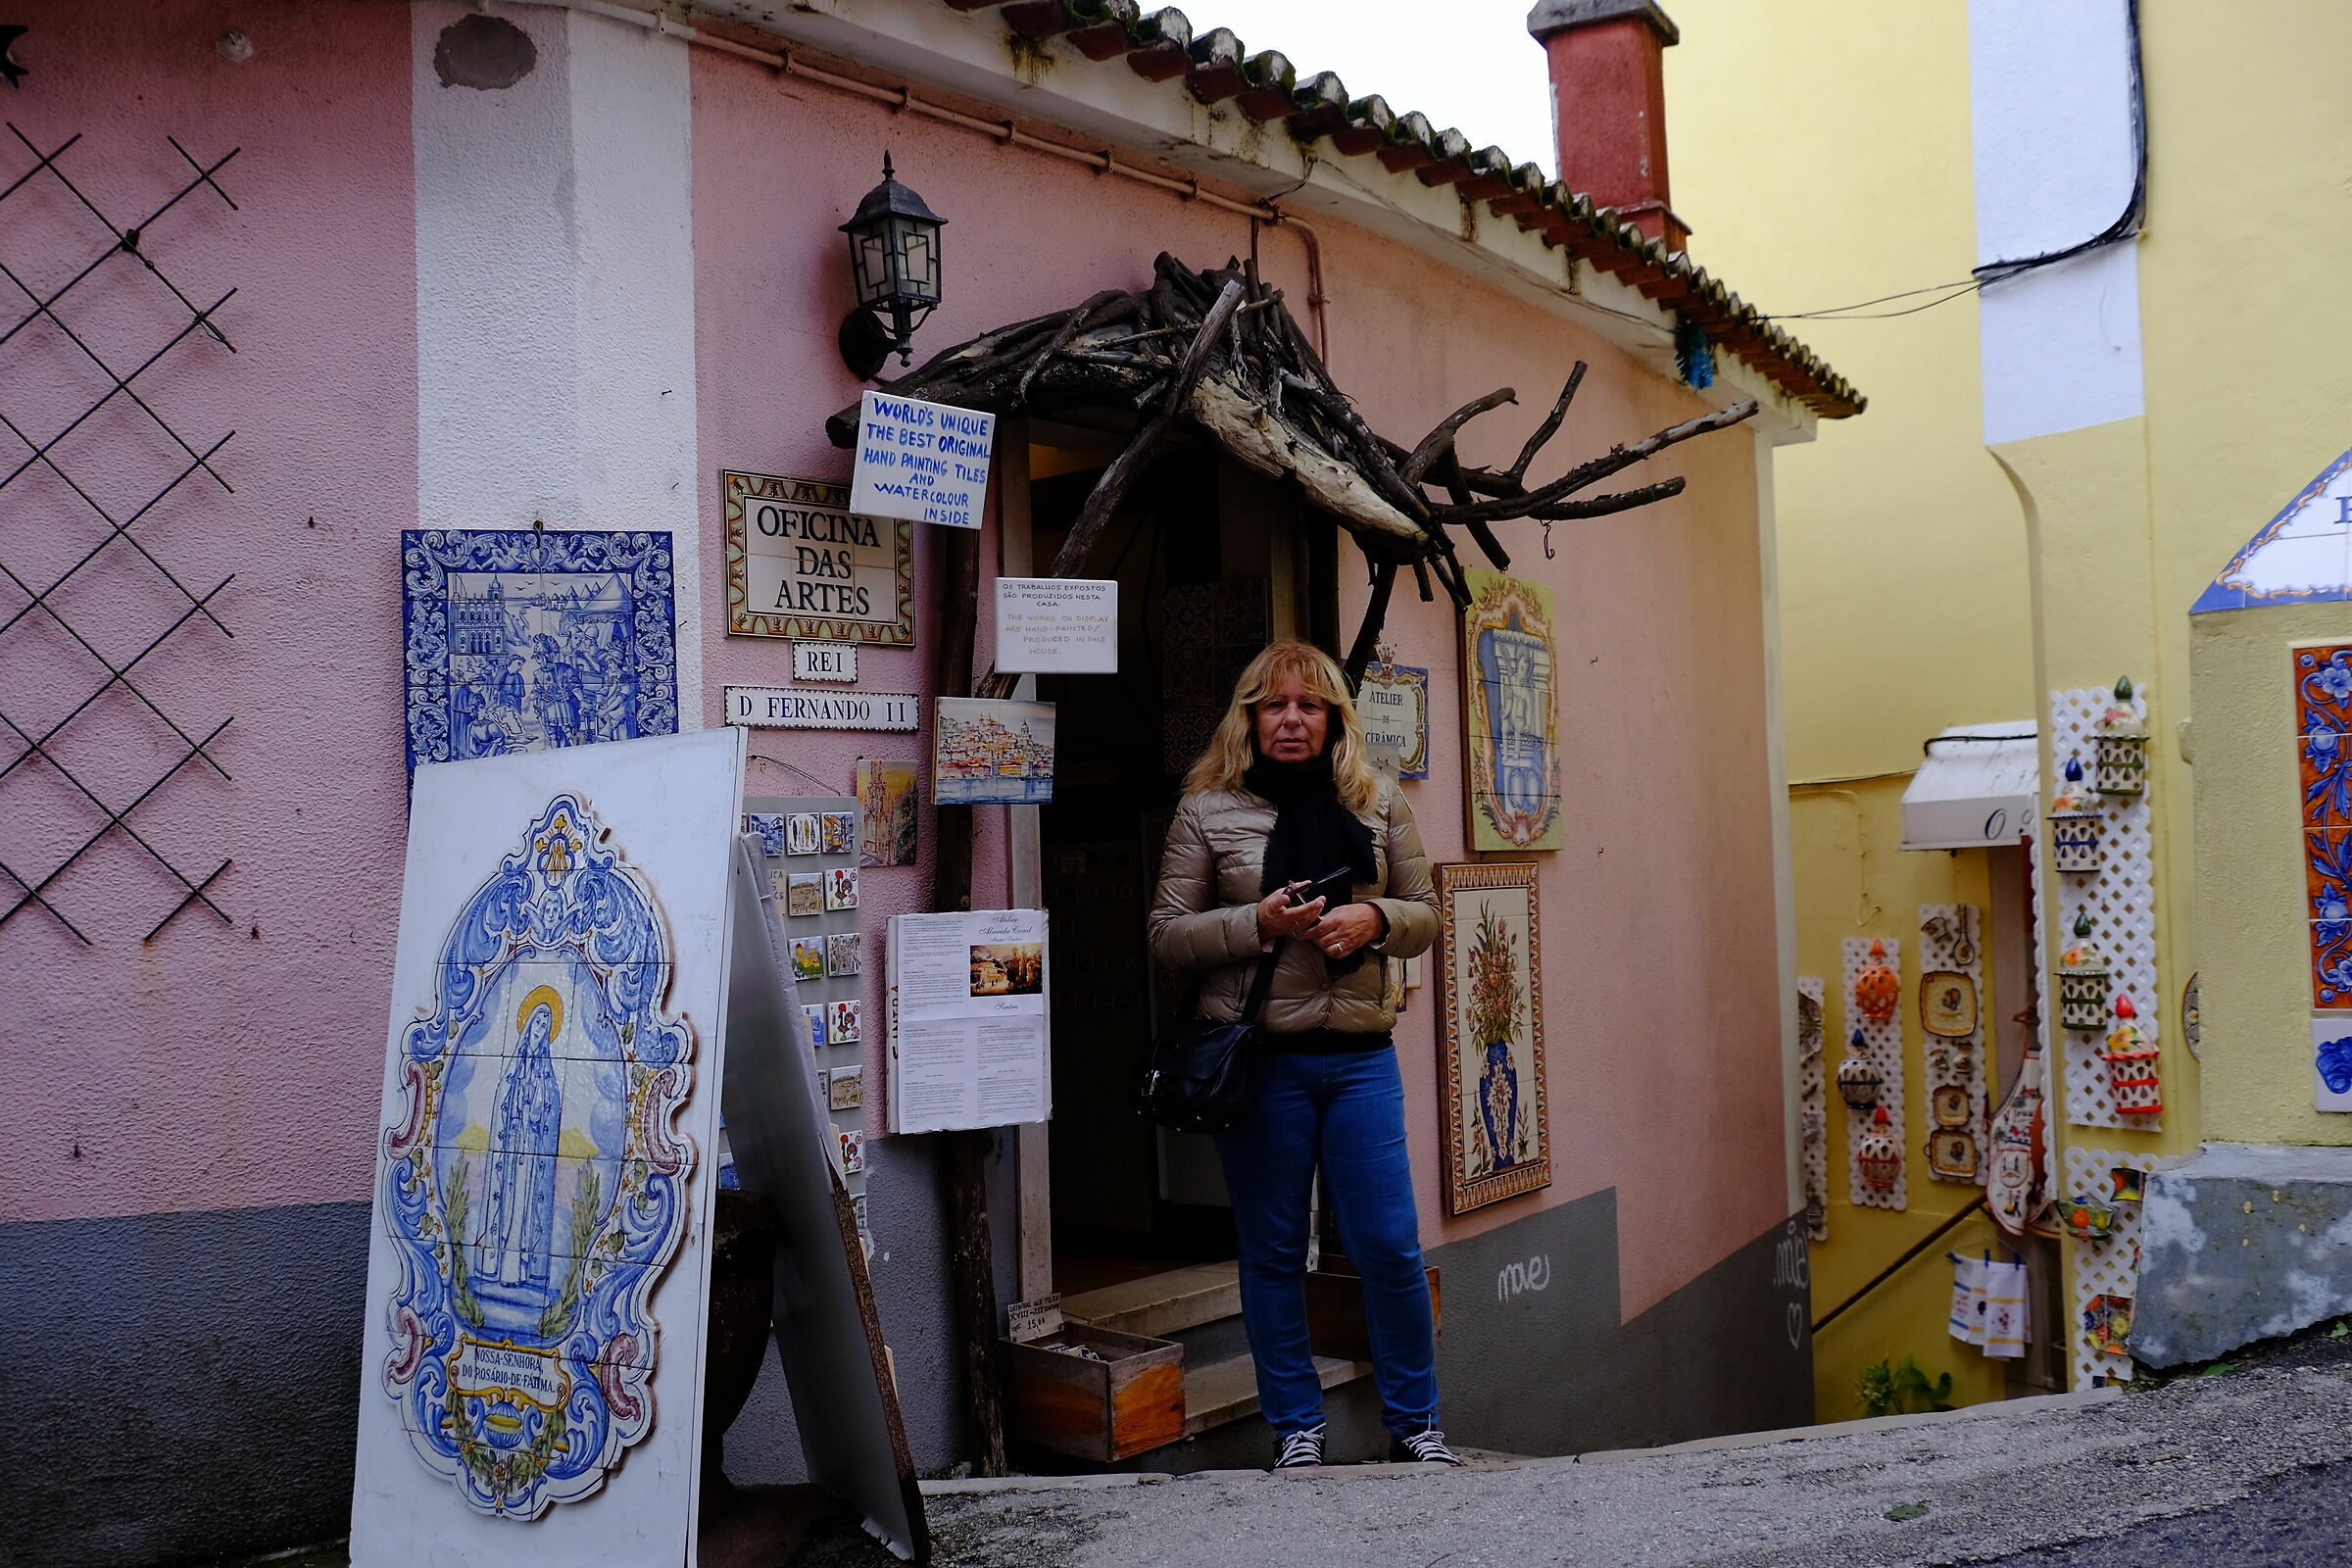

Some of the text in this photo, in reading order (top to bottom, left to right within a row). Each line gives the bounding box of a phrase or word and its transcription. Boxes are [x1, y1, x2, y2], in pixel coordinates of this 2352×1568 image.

[874, 398, 988, 436] WORLD'S UNIQUE
[867, 423, 991, 459] THE BEST ORIGINAL
[864, 448, 985, 483] HAND PAINTING TILES
[909, 473, 934, 486] AND
[874, 483, 968, 508] WATERCOLOUR
[758, 506, 881, 548] OFICINA
[924, 509, 969, 524] INSIDE
[796, 546, 851, 579] DAS
[774, 580, 869, 615] ARTES
[808, 652, 842, 672] REI
[740, 696, 752, 716] D
[767, 698, 869, 721] FERNANDO
[1369, 692, 1403, 706] ATELIER
[463, 1364, 472, 1377] DO
